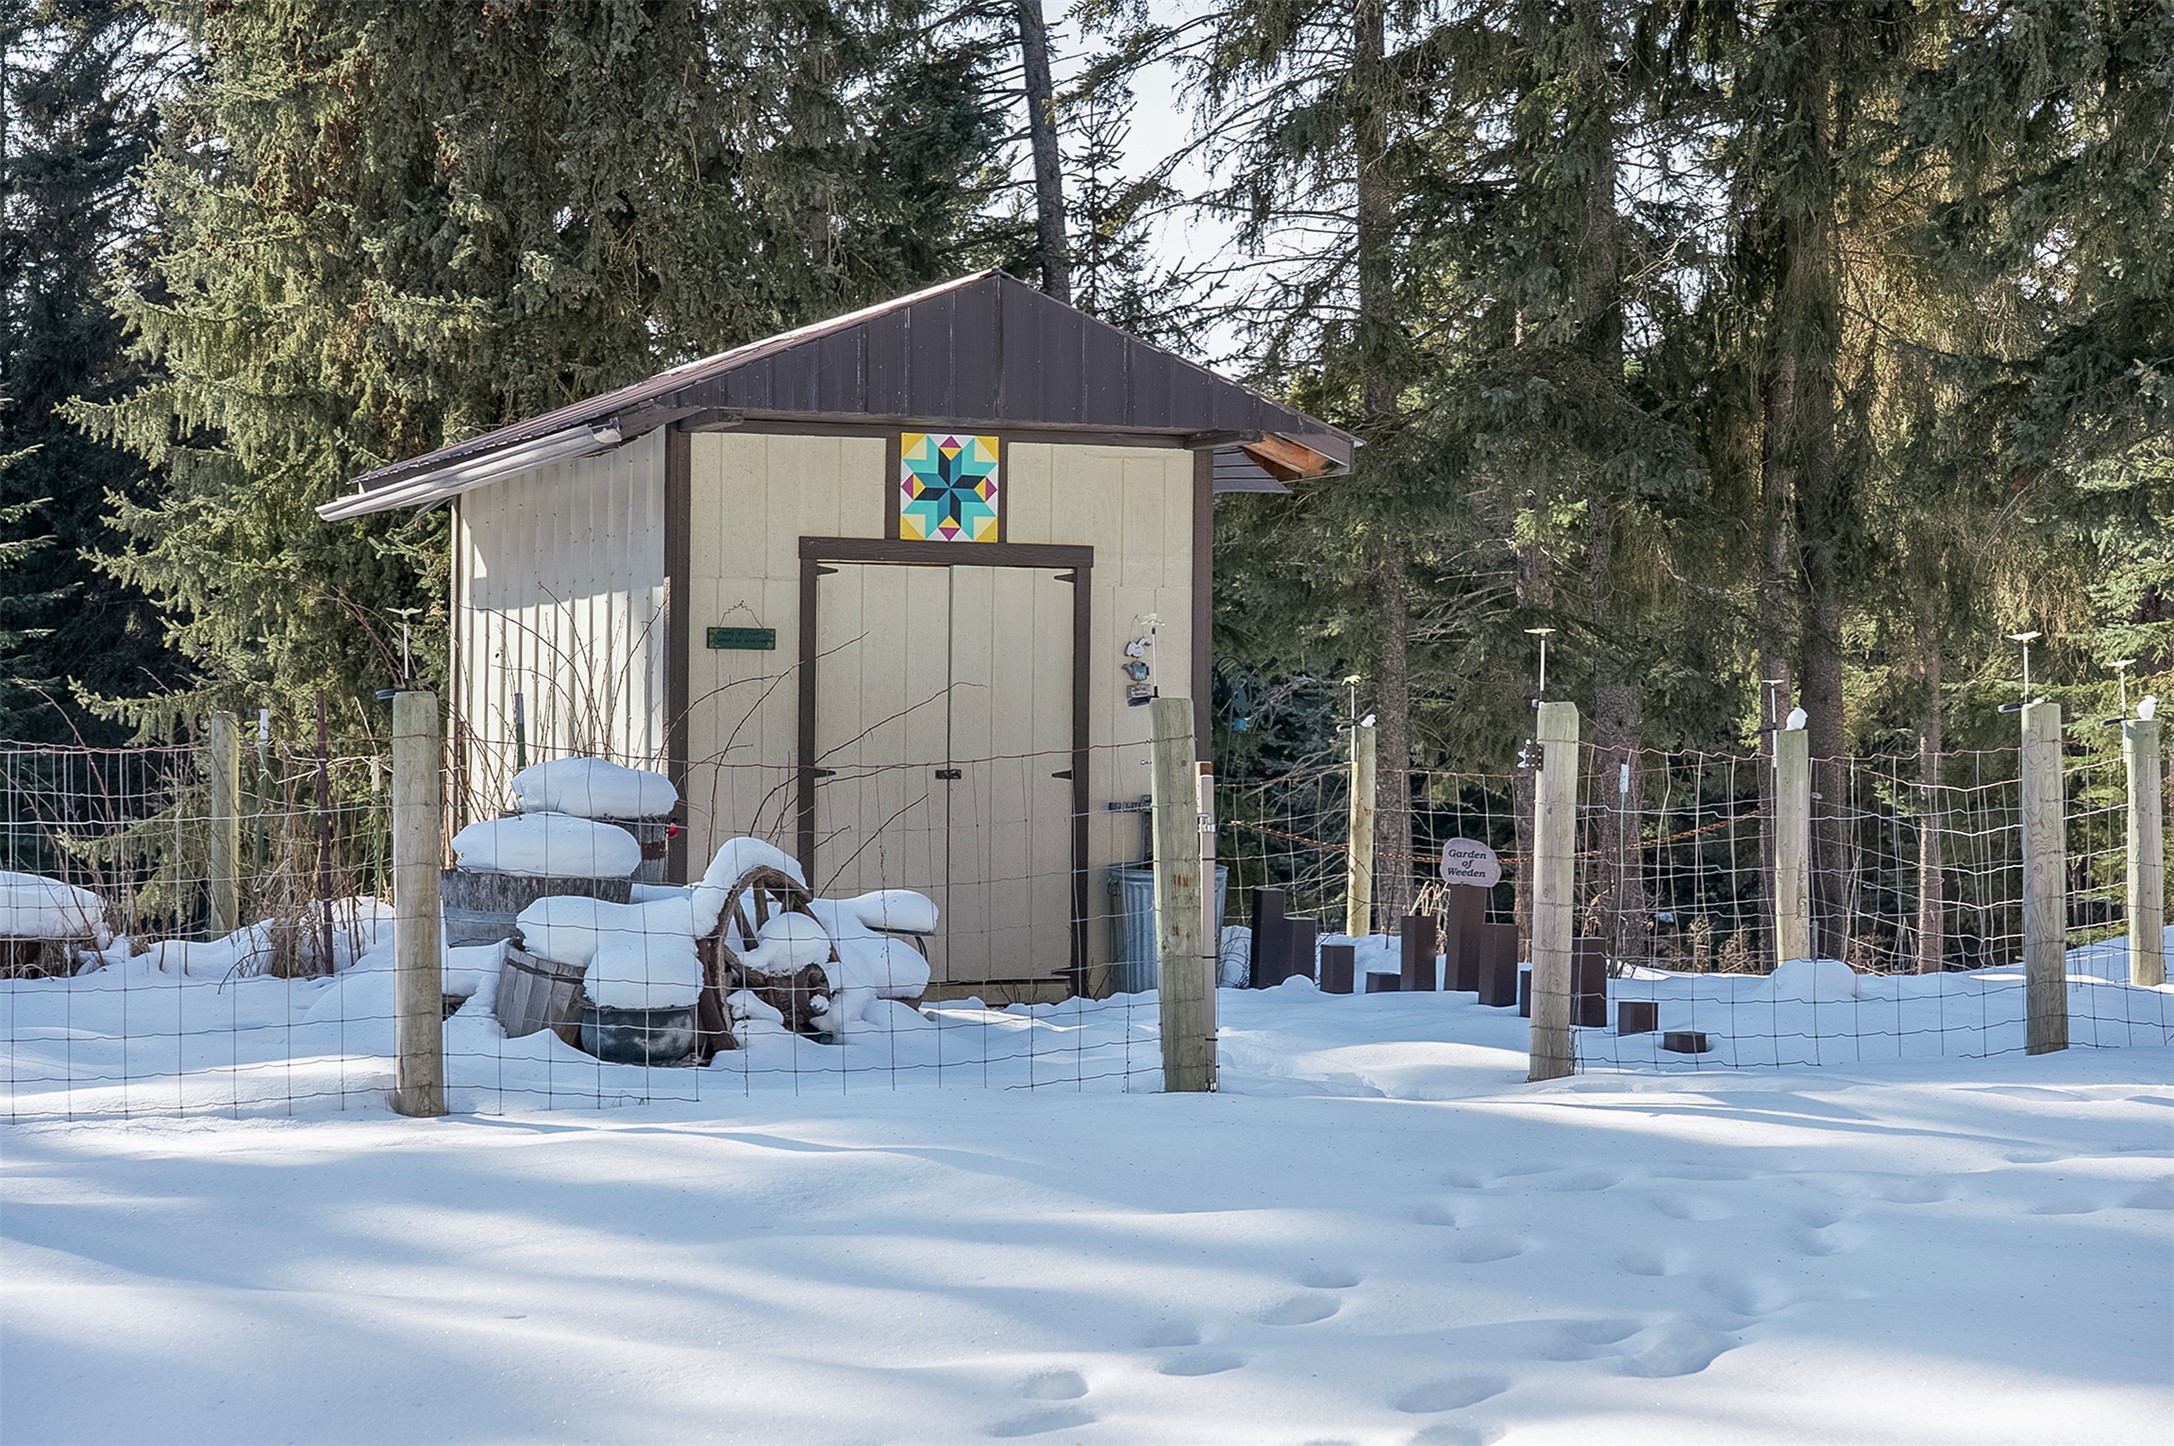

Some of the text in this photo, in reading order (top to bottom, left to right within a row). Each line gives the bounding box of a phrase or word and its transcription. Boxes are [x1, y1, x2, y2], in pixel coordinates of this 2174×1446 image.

[1448, 848, 1487, 860] Garden
[1461, 859, 1475, 869] of
[1447, 867, 1486, 878] Weeden
